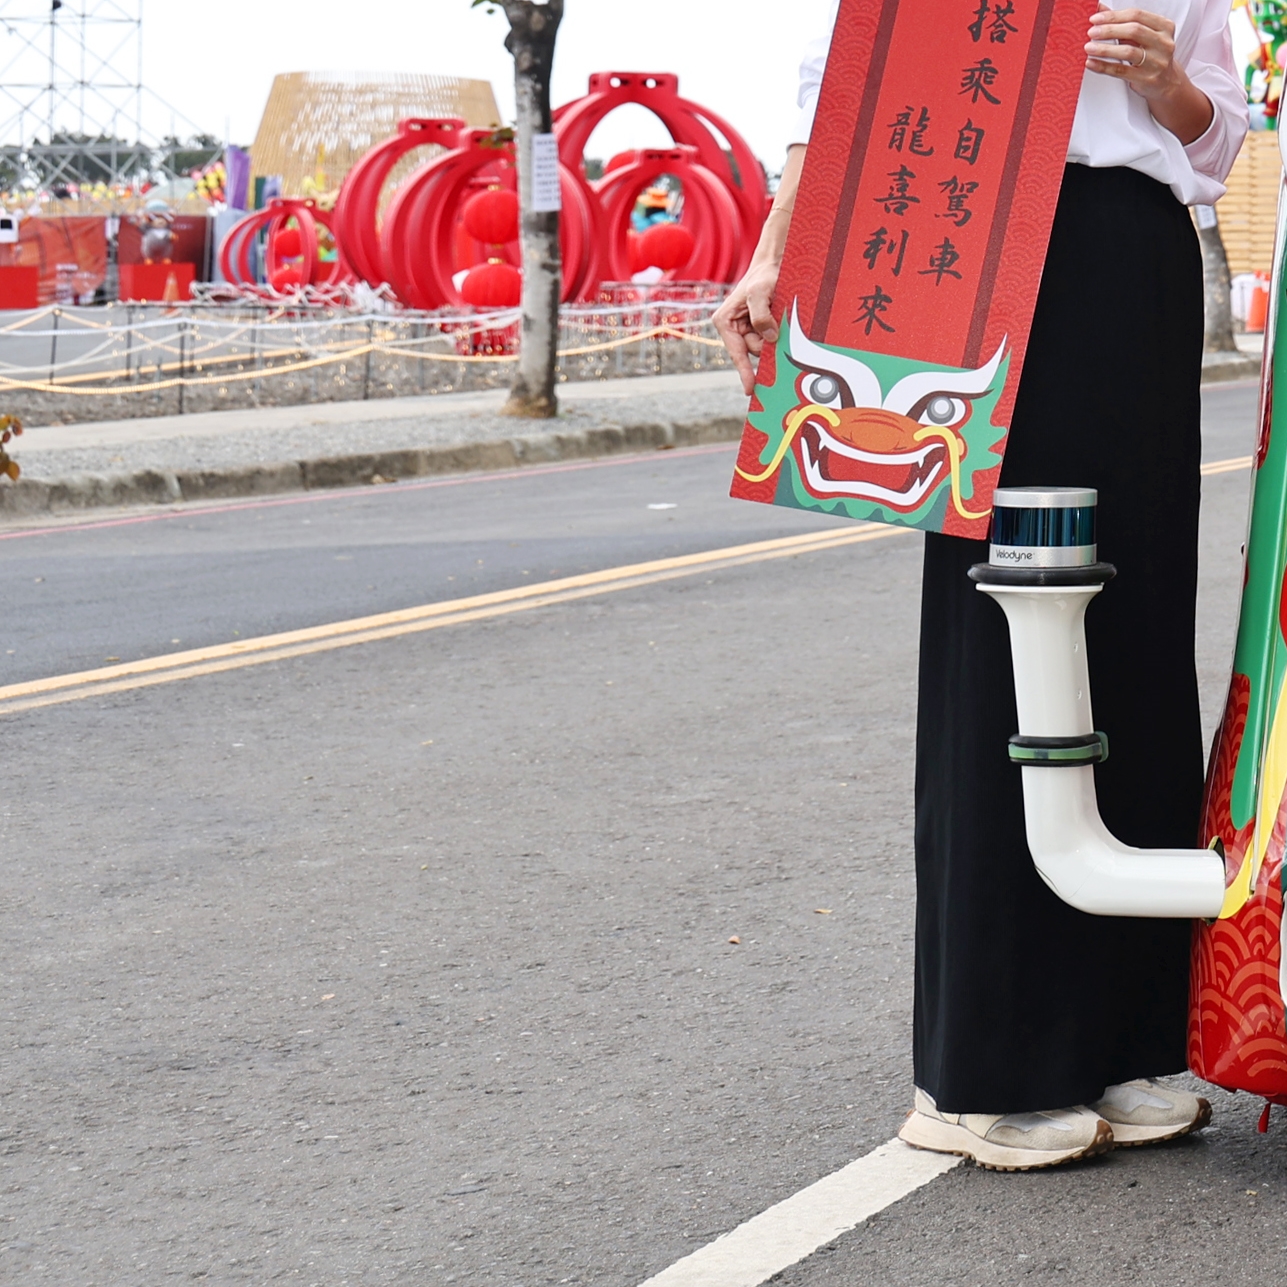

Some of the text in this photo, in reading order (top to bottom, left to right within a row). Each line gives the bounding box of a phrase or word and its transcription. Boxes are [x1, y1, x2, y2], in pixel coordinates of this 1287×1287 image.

[851, 105, 935, 336] 龍喜利來
[996, 550, 1033, 563] Velodyne
